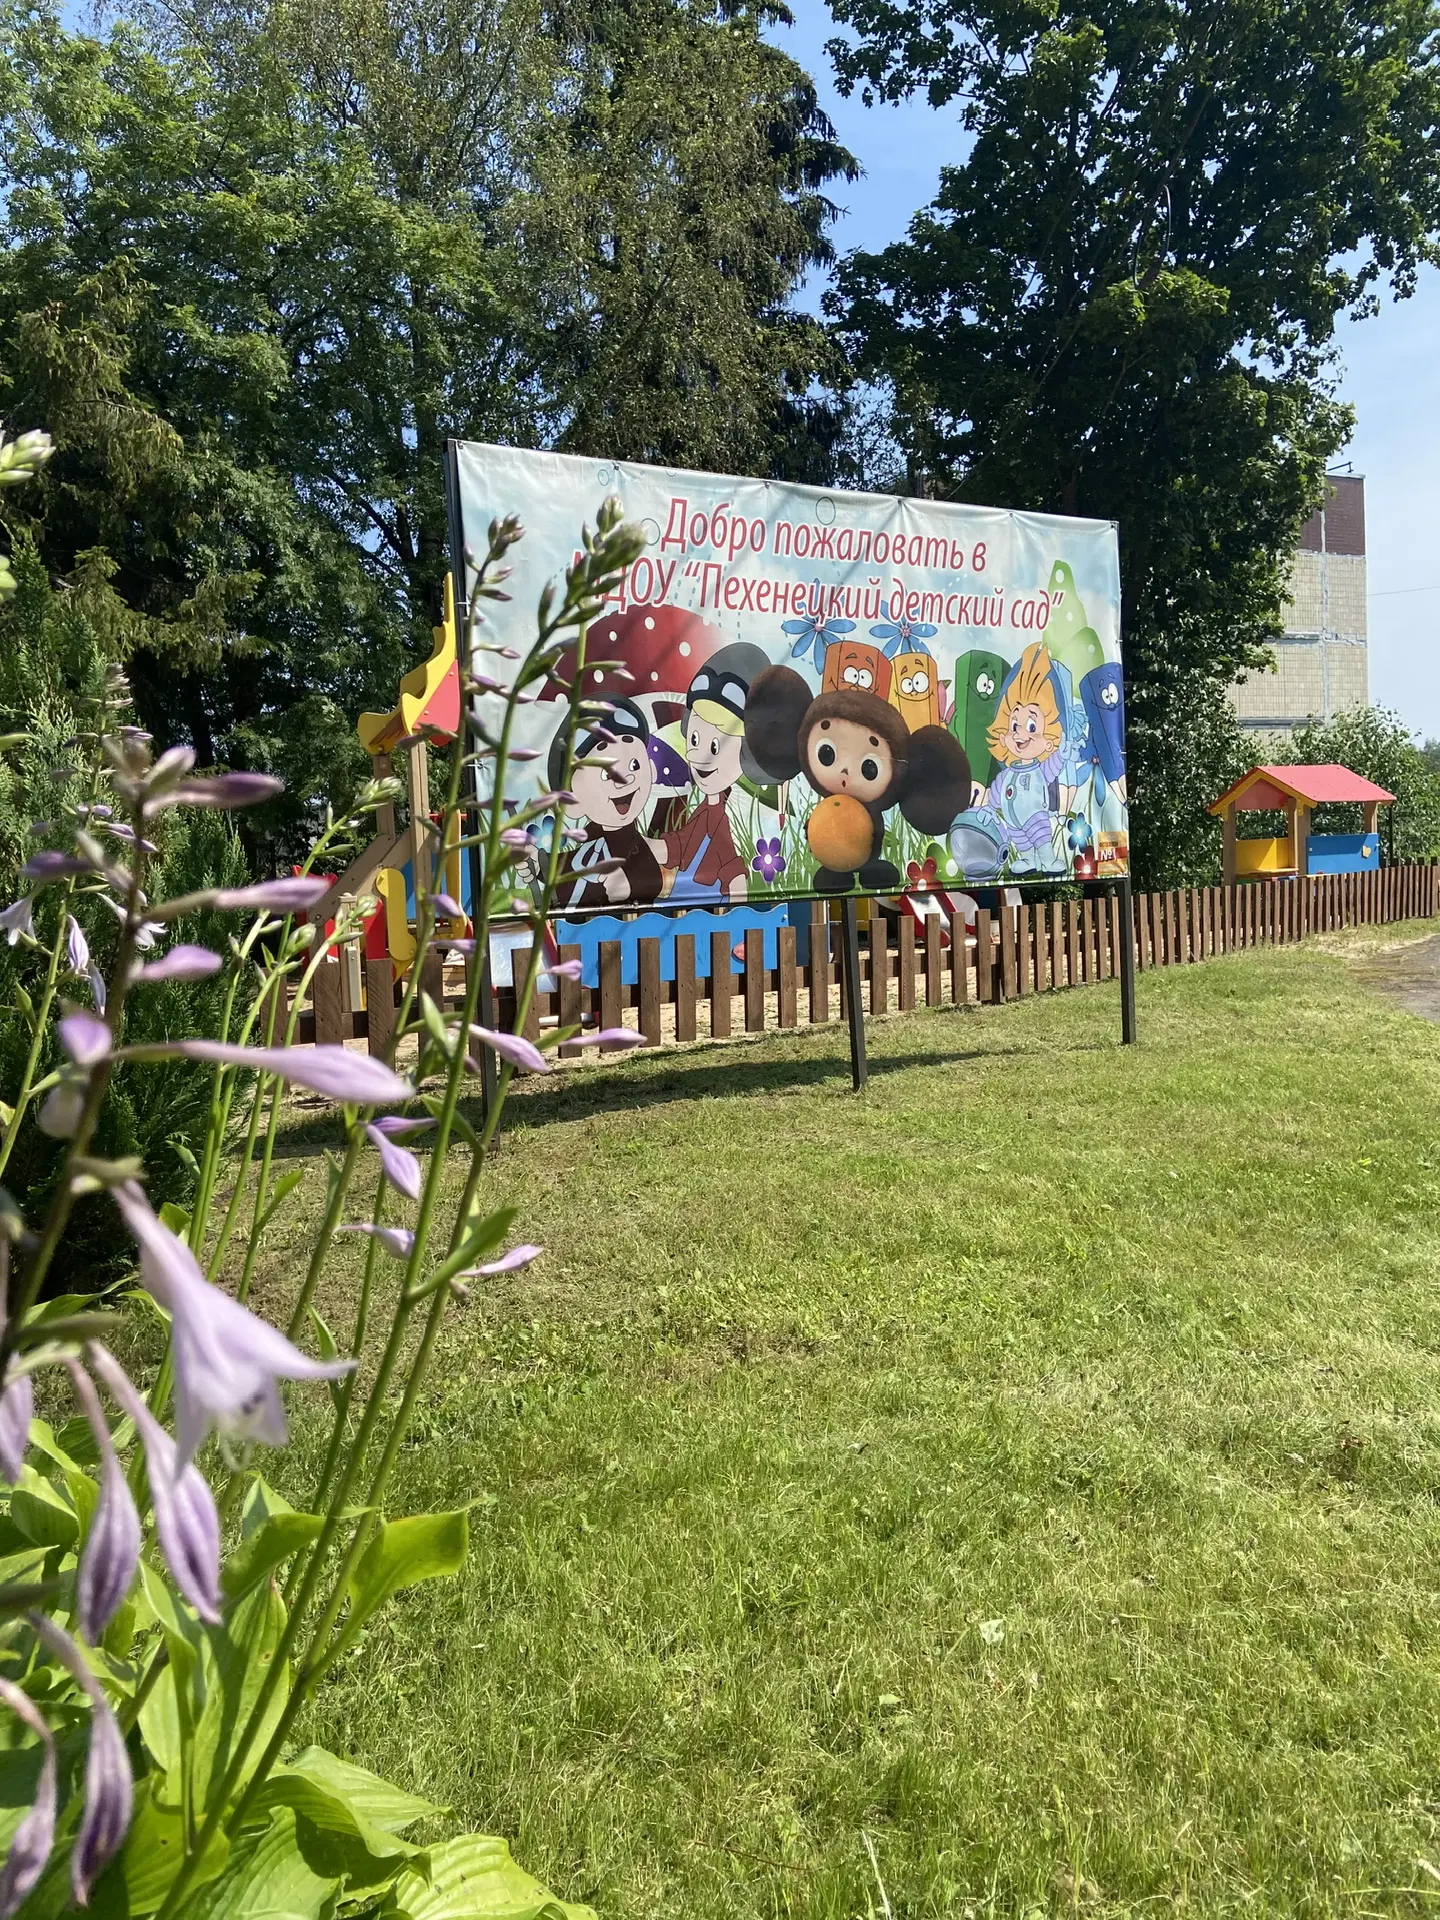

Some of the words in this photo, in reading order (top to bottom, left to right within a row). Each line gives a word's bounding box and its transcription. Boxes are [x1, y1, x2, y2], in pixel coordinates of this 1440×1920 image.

[660, 497, 767, 561] Добро
[773, 520, 965, 571] пожаловать
[971, 541, 988, 572] в
[684, 560, 880, 623] “Пехенецкий
[889, 577, 1003, 627] детский
[1010, 589, 1065, 630] сад”
